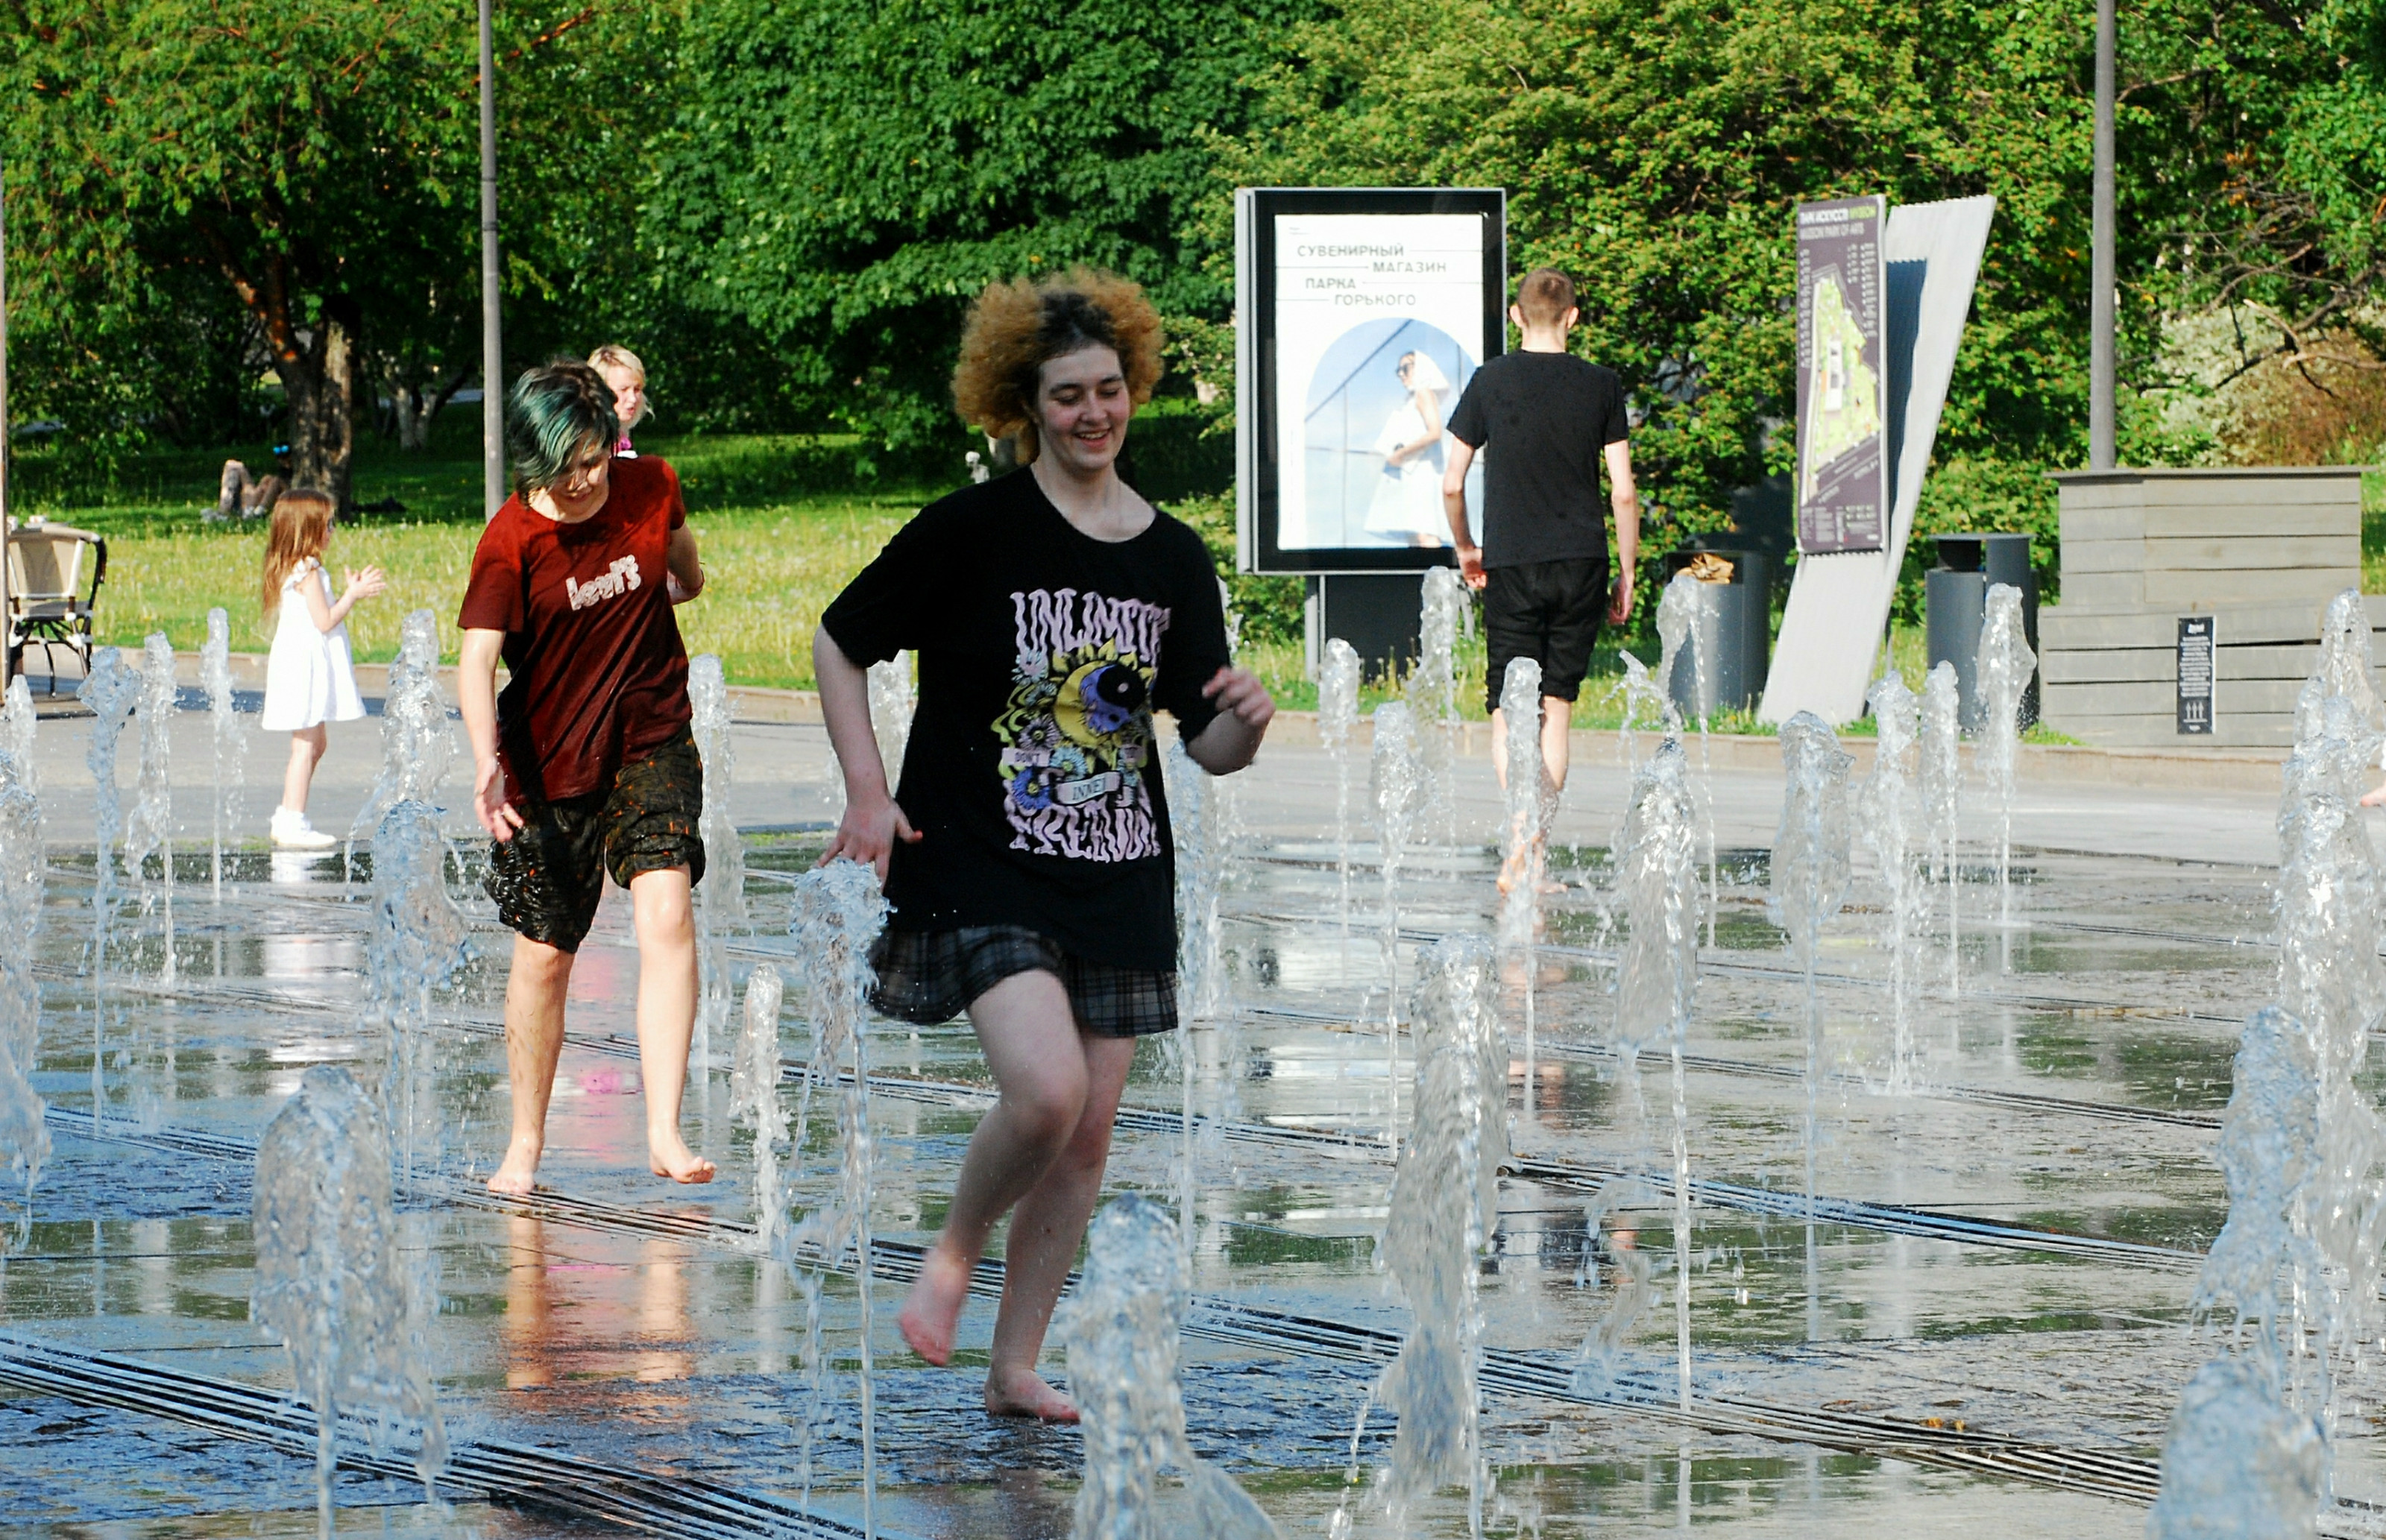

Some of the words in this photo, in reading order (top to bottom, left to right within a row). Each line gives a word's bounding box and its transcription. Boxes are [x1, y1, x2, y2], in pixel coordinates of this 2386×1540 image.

[1297, 243, 1404, 257] СУВЕНИРНЫЙ
[1373, 262, 1447, 274] МАГАЗИН
[1306, 278, 1356, 289] ПАРКА
[1335, 294, 1416, 306] ГОРЬКОГО
[1010, 587, 1171, 669] UNLIMITE
